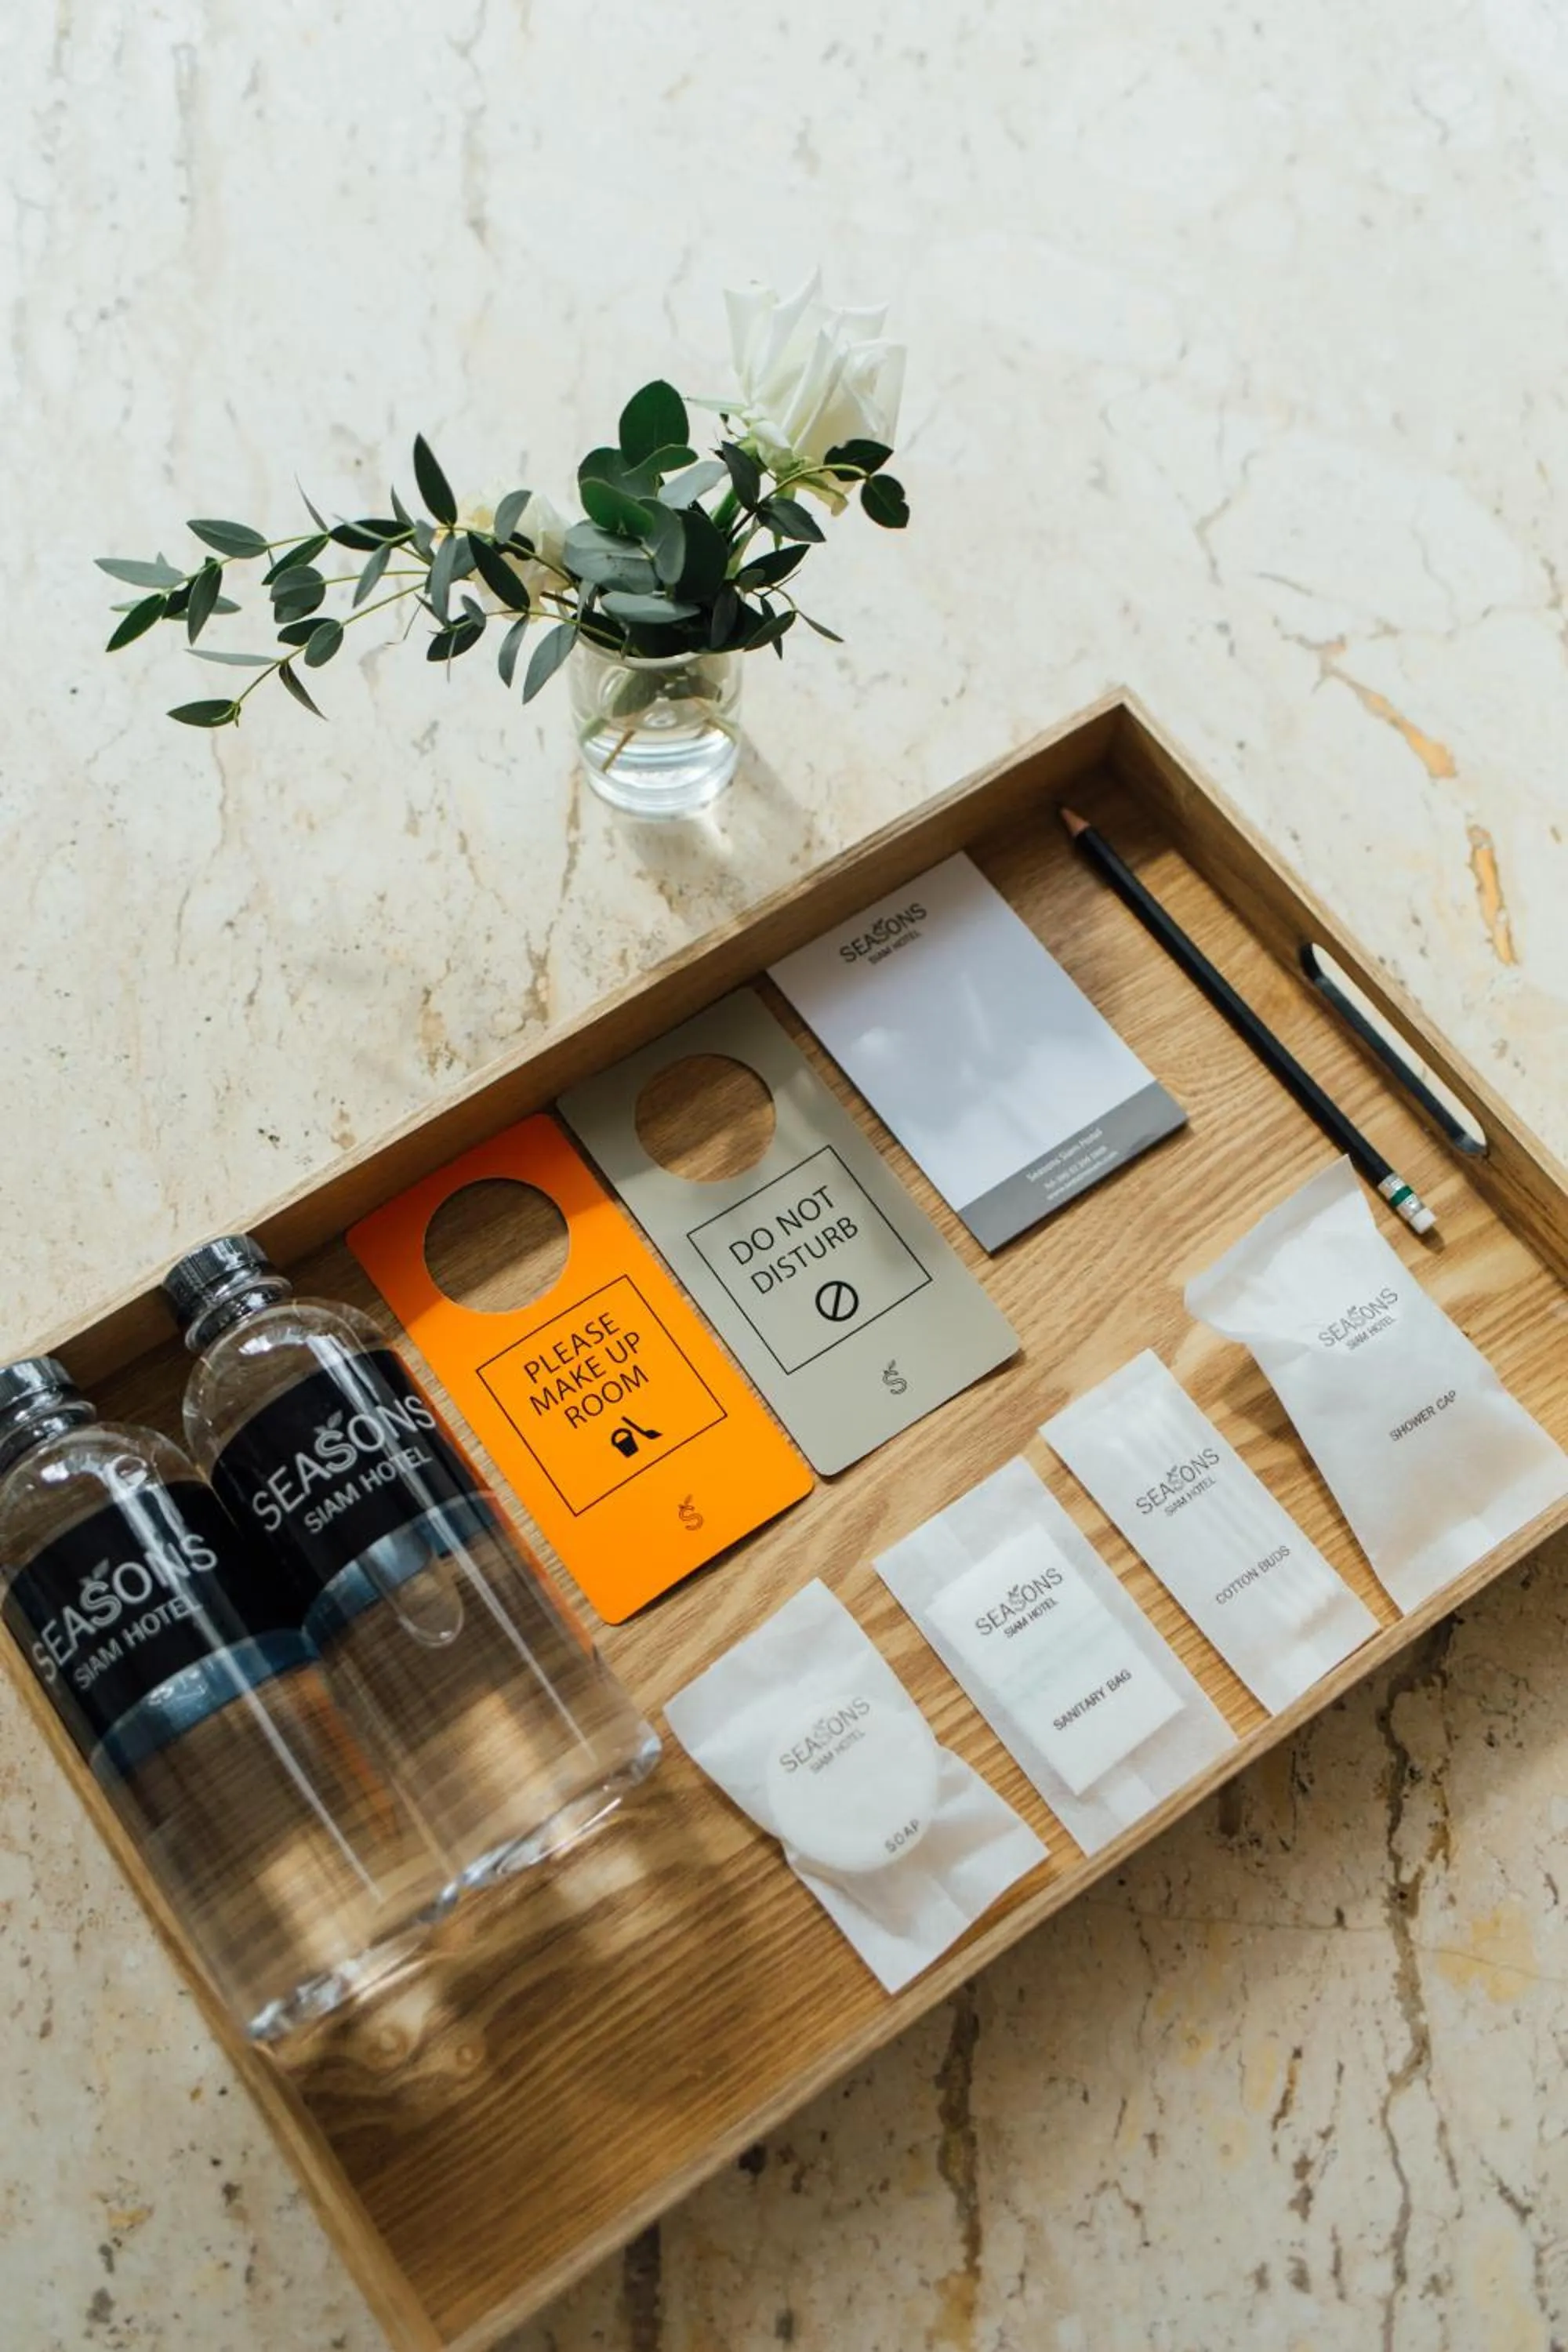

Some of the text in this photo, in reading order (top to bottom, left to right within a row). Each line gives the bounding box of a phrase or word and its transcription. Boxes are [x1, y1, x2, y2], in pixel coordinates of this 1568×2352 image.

[840, 902, 927, 963] SEASONS
[729, 1185, 833, 1265] DO NOT
[751, 1217, 858, 1294] DISTURB
[524, 1312, 620, 1384] PLEASE
[1318, 1287, 1398, 1347] SEASONS
[529, 1331, 640, 1416] MAKE UP
[564, 1365, 649, 1429] ROOM
[1389, 1389, 1456, 1442] SHOWER CAP
[252, 1396, 436, 1531] SEASONS
[304, 1446, 433, 1534] SIAM HOTEL
[1136, 1448, 1220, 1515] SEASONS
[31, 1534, 217, 1682] SEASONS
[975, 1567, 1063, 1635] SEASONS
[1215, 1544, 1290, 1605] COTTON BUDS
[74, 1637, 124, 1690] SIAM
[1053, 1668, 1132, 1731] SANITARY BAG
[779, 1696, 870, 1773] SEASONS
[884, 1818, 919, 1854] SOAP
